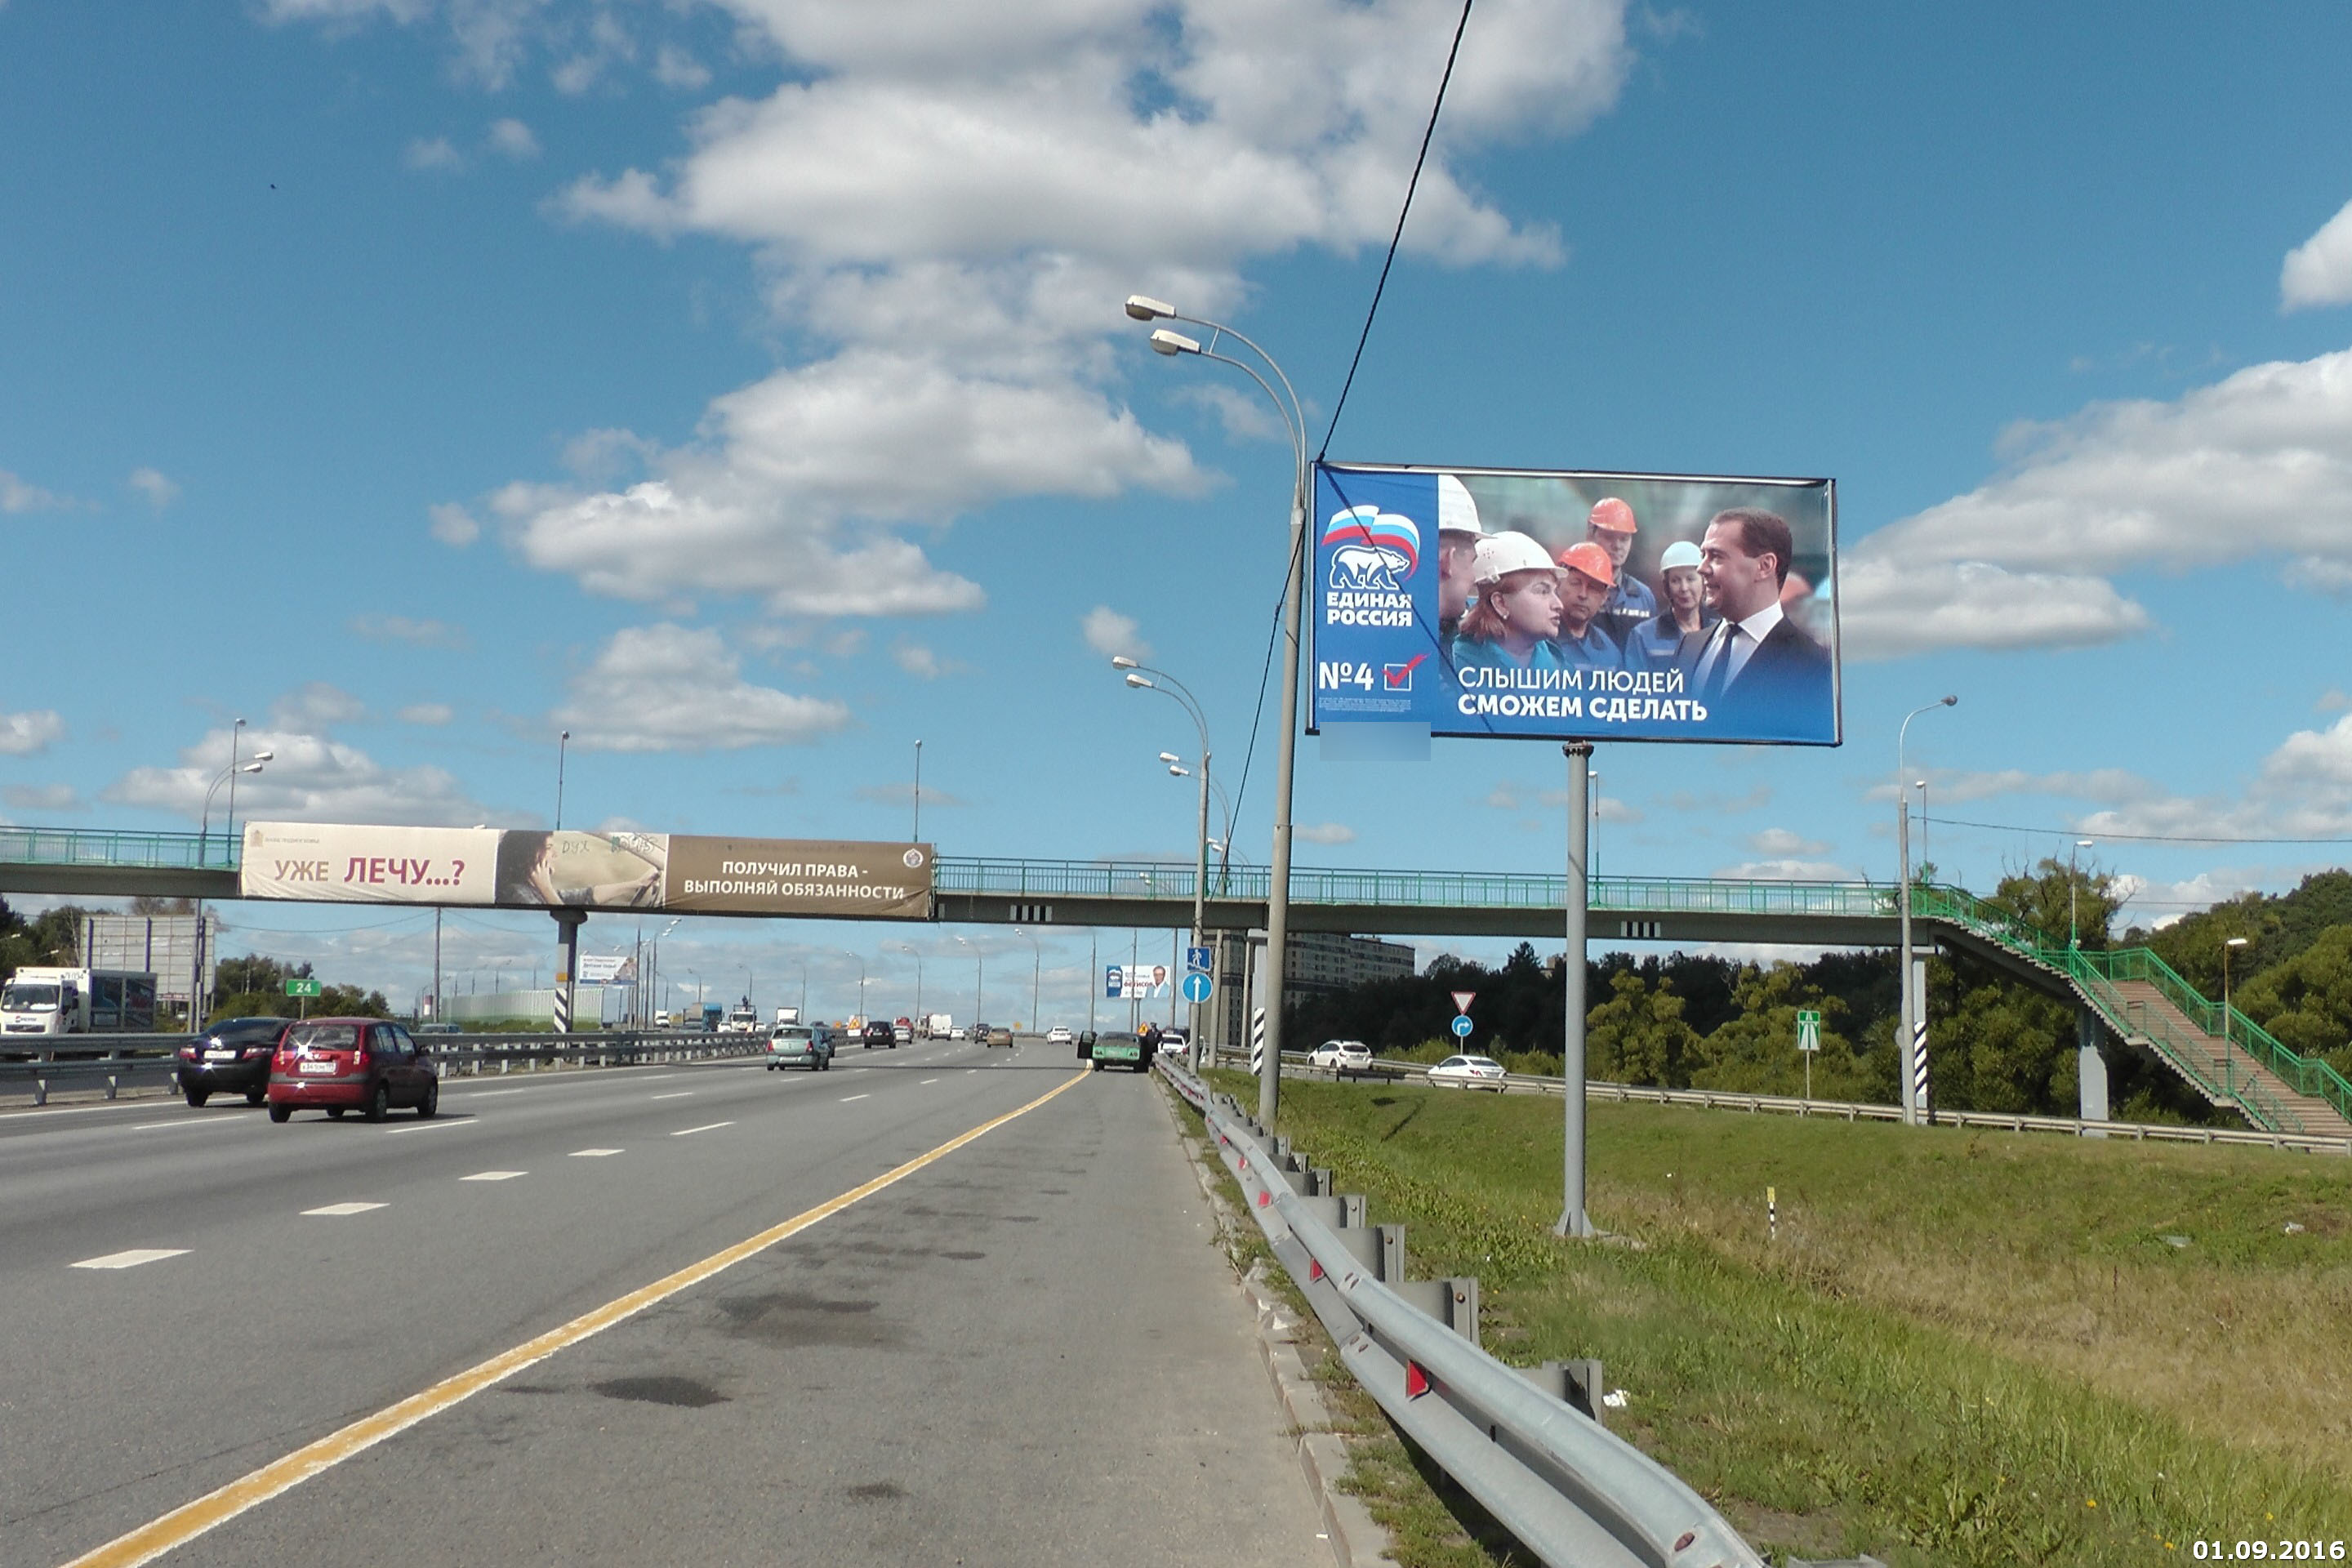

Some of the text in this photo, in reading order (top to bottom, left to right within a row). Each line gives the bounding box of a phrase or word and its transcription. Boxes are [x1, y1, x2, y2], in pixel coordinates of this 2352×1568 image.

[1326, 591, 1412, 608] ЕДИНАЯ
[1326, 609, 1412, 626] РОССИЯ
[1319, 662, 1374, 691] №4
[1458, 666, 1684, 695] СЛЫШИМ ЛЮДЕЙ
[1458, 693, 1708, 722] СМОЖЕМ СДЕЛАТЬ
[274, 857, 465, 886] УЖЕ ЛЕЧУ...?
[722, 861, 802, 877] ПОЛУЧИЛ
[804, 862, 858, 878] ПРАВА
[684, 879, 904, 900] ВЫПОЛНЯЙ ОБЯЗАННОСТИ
[296, 982, 312, 993] 24
